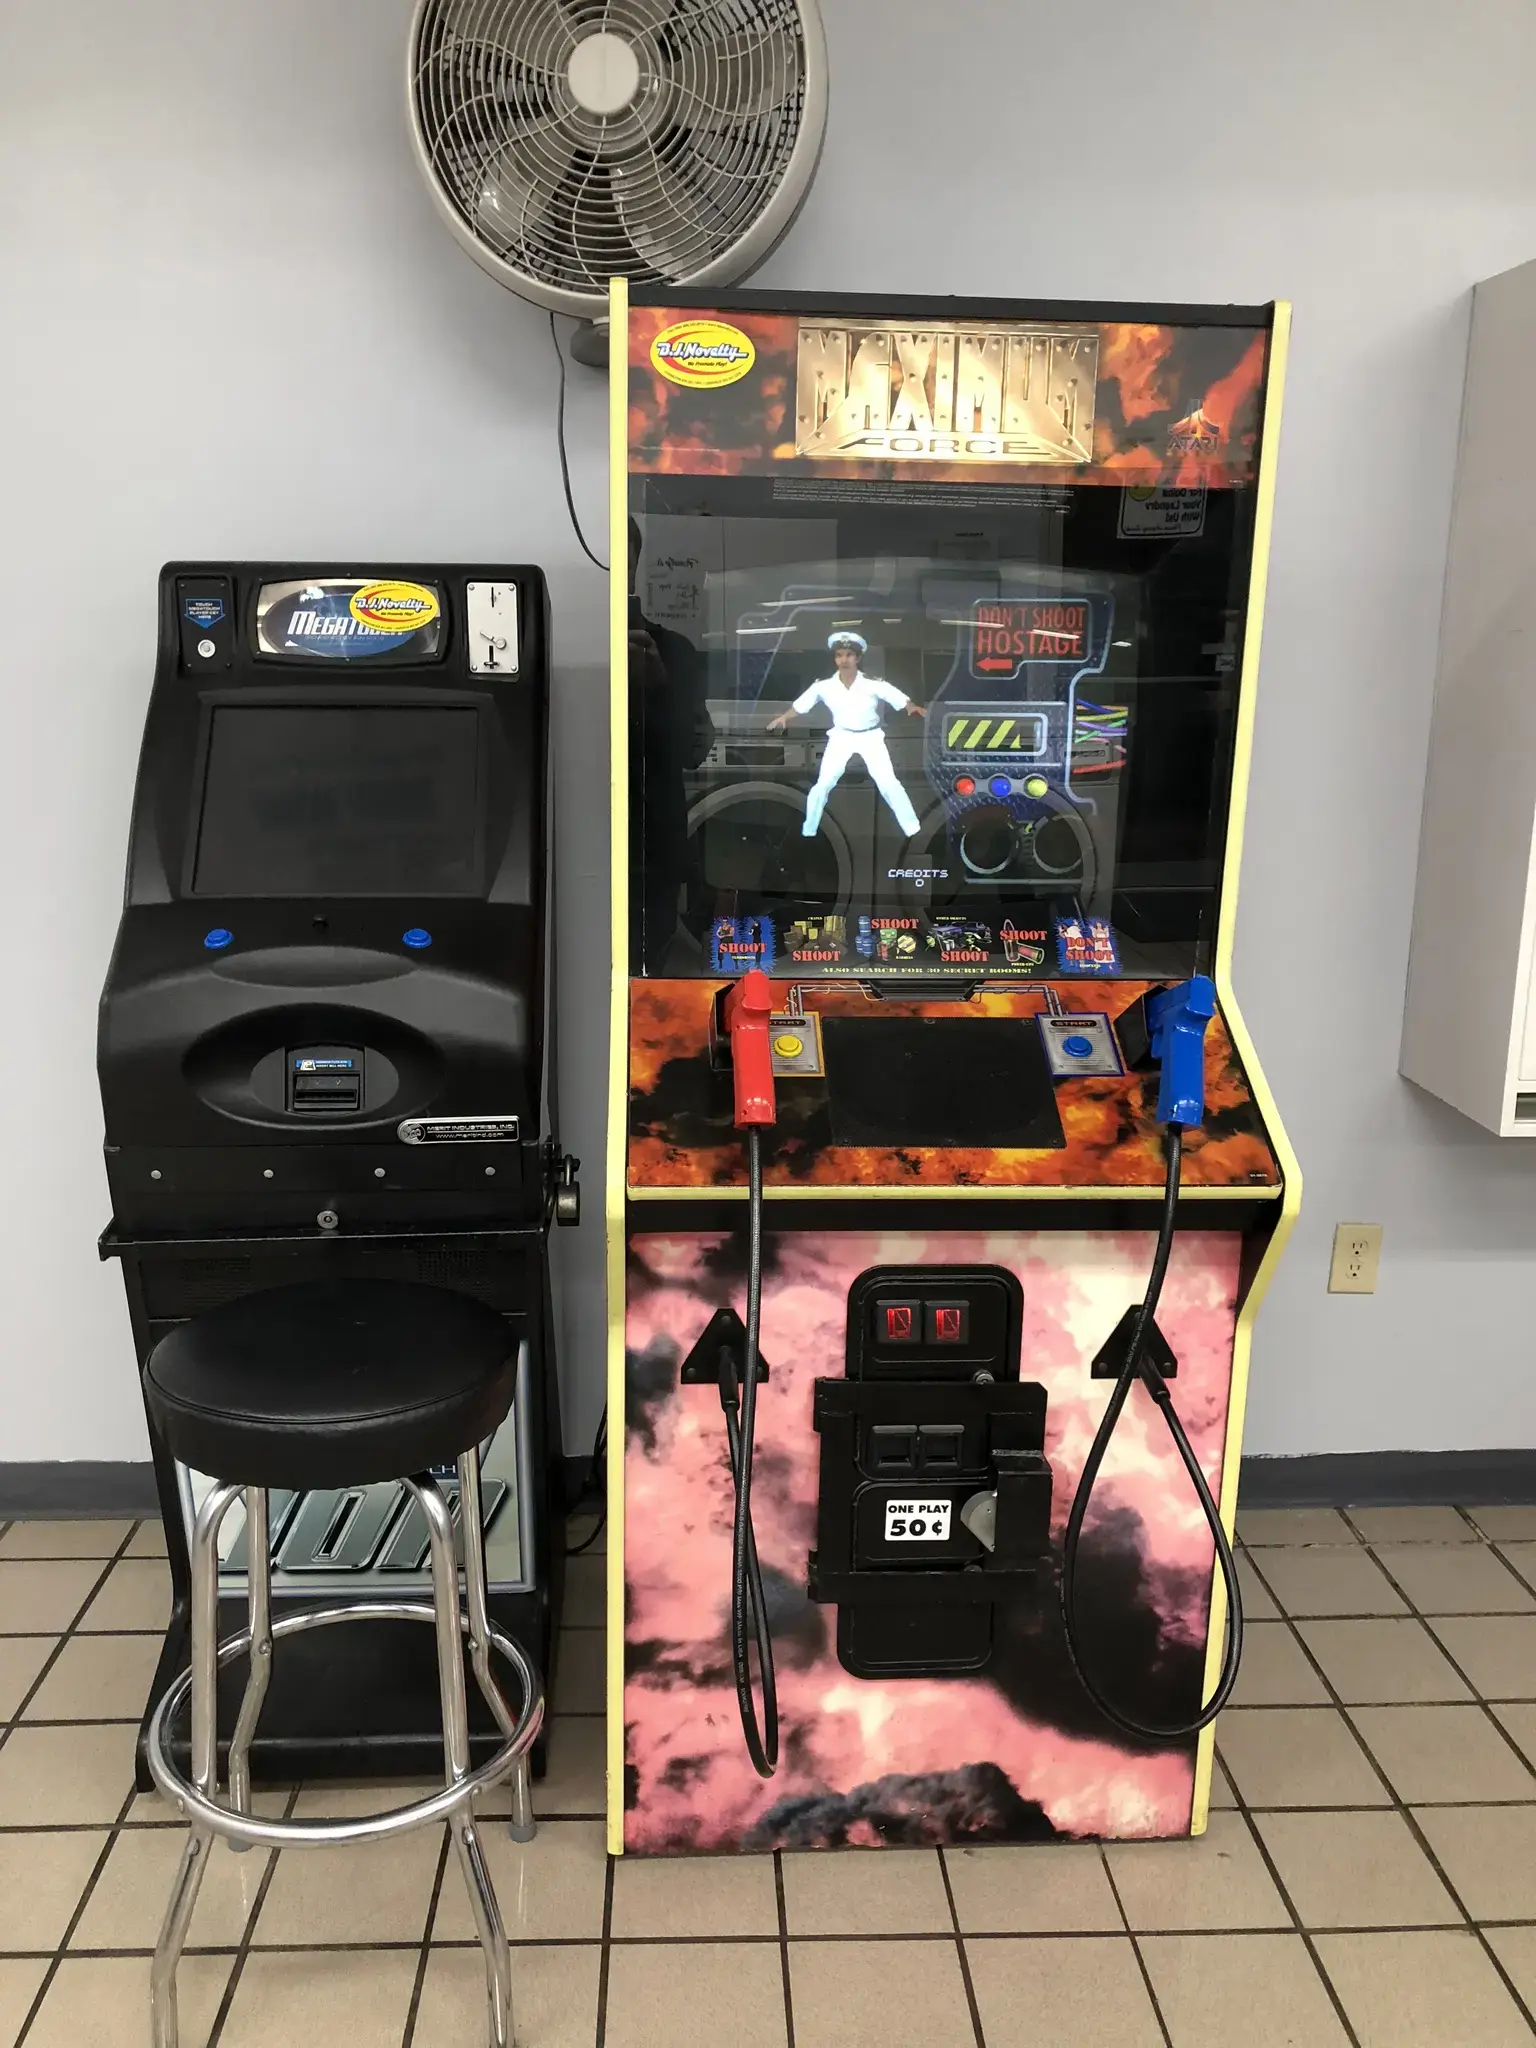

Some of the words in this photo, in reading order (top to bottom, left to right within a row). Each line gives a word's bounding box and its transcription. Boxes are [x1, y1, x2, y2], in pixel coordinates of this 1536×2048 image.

[796, 329, 1099, 462] MAXIMUM
[837, 437, 1057, 455] FORCE
[1168, 436, 1218, 450] ATARI
[1032, 607, 1085, 628] SHOOT
[977, 629, 1084, 655] HOSTAGE
[888, 869, 948, 877] CREDITS
[871, 919, 919, 929] SHOOT
[1000, 930, 1047, 940] SHOOT
[719, 943, 767, 953] SHOOT
[792, 950, 841, 961] SHOOT
[941, 951, 989, 961] SHOOT
[1065, 950, 1113, 960] SHOOT
[888, 1505, 914, 1513] ONE
[918, 1505, 949, 1513] PLAY
